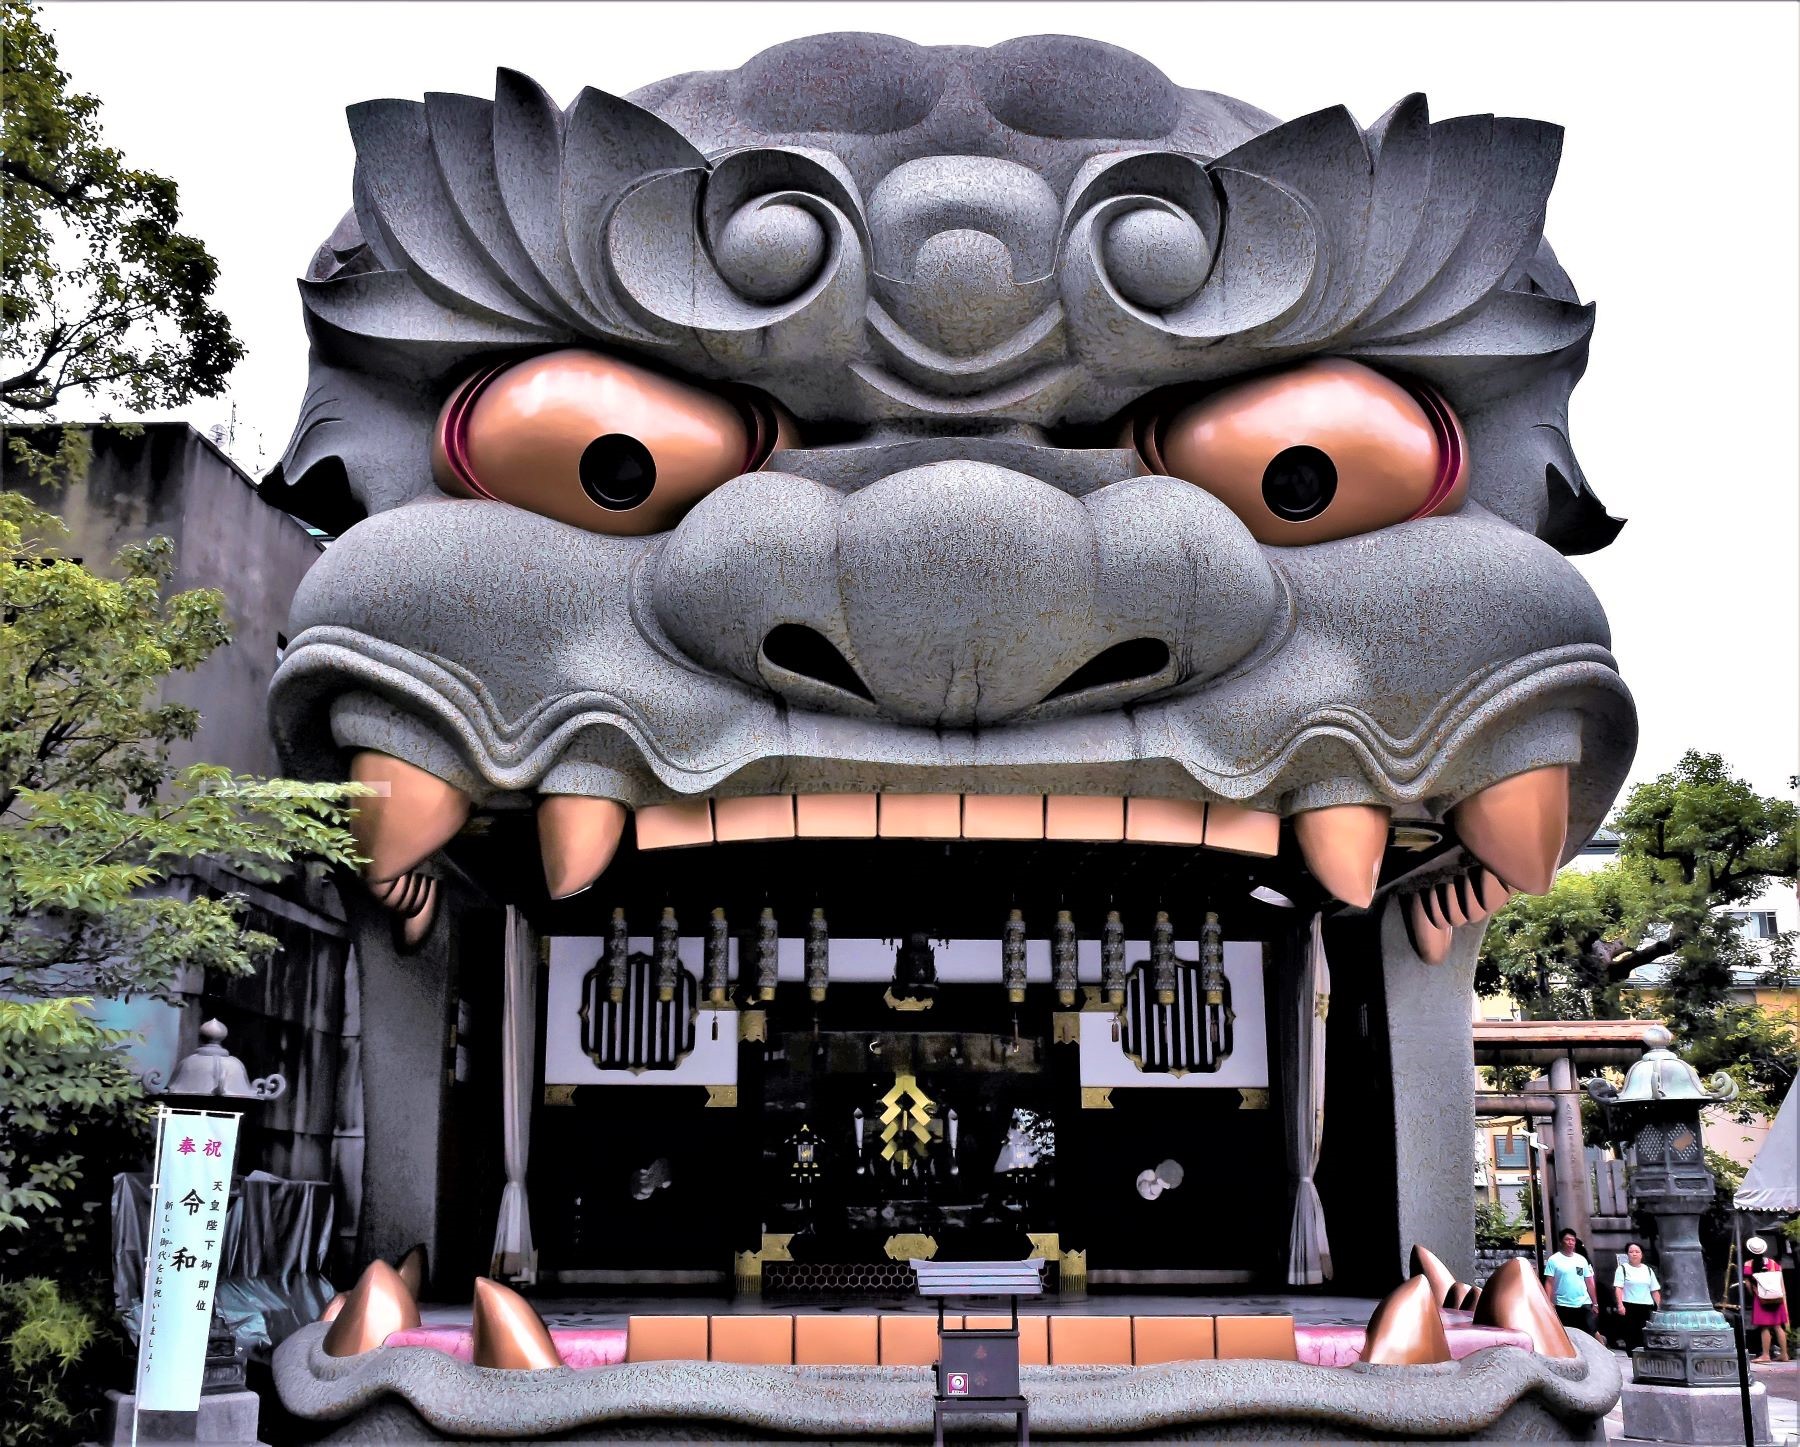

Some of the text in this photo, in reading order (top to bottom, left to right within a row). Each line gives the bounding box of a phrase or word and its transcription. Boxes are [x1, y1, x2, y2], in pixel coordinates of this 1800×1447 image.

[177, 1136, 222, 1157] 奉祝
[170, 1188, 205, 1272] 令和
[196, 1181, 223, 1311] 天皇陛下御即位
